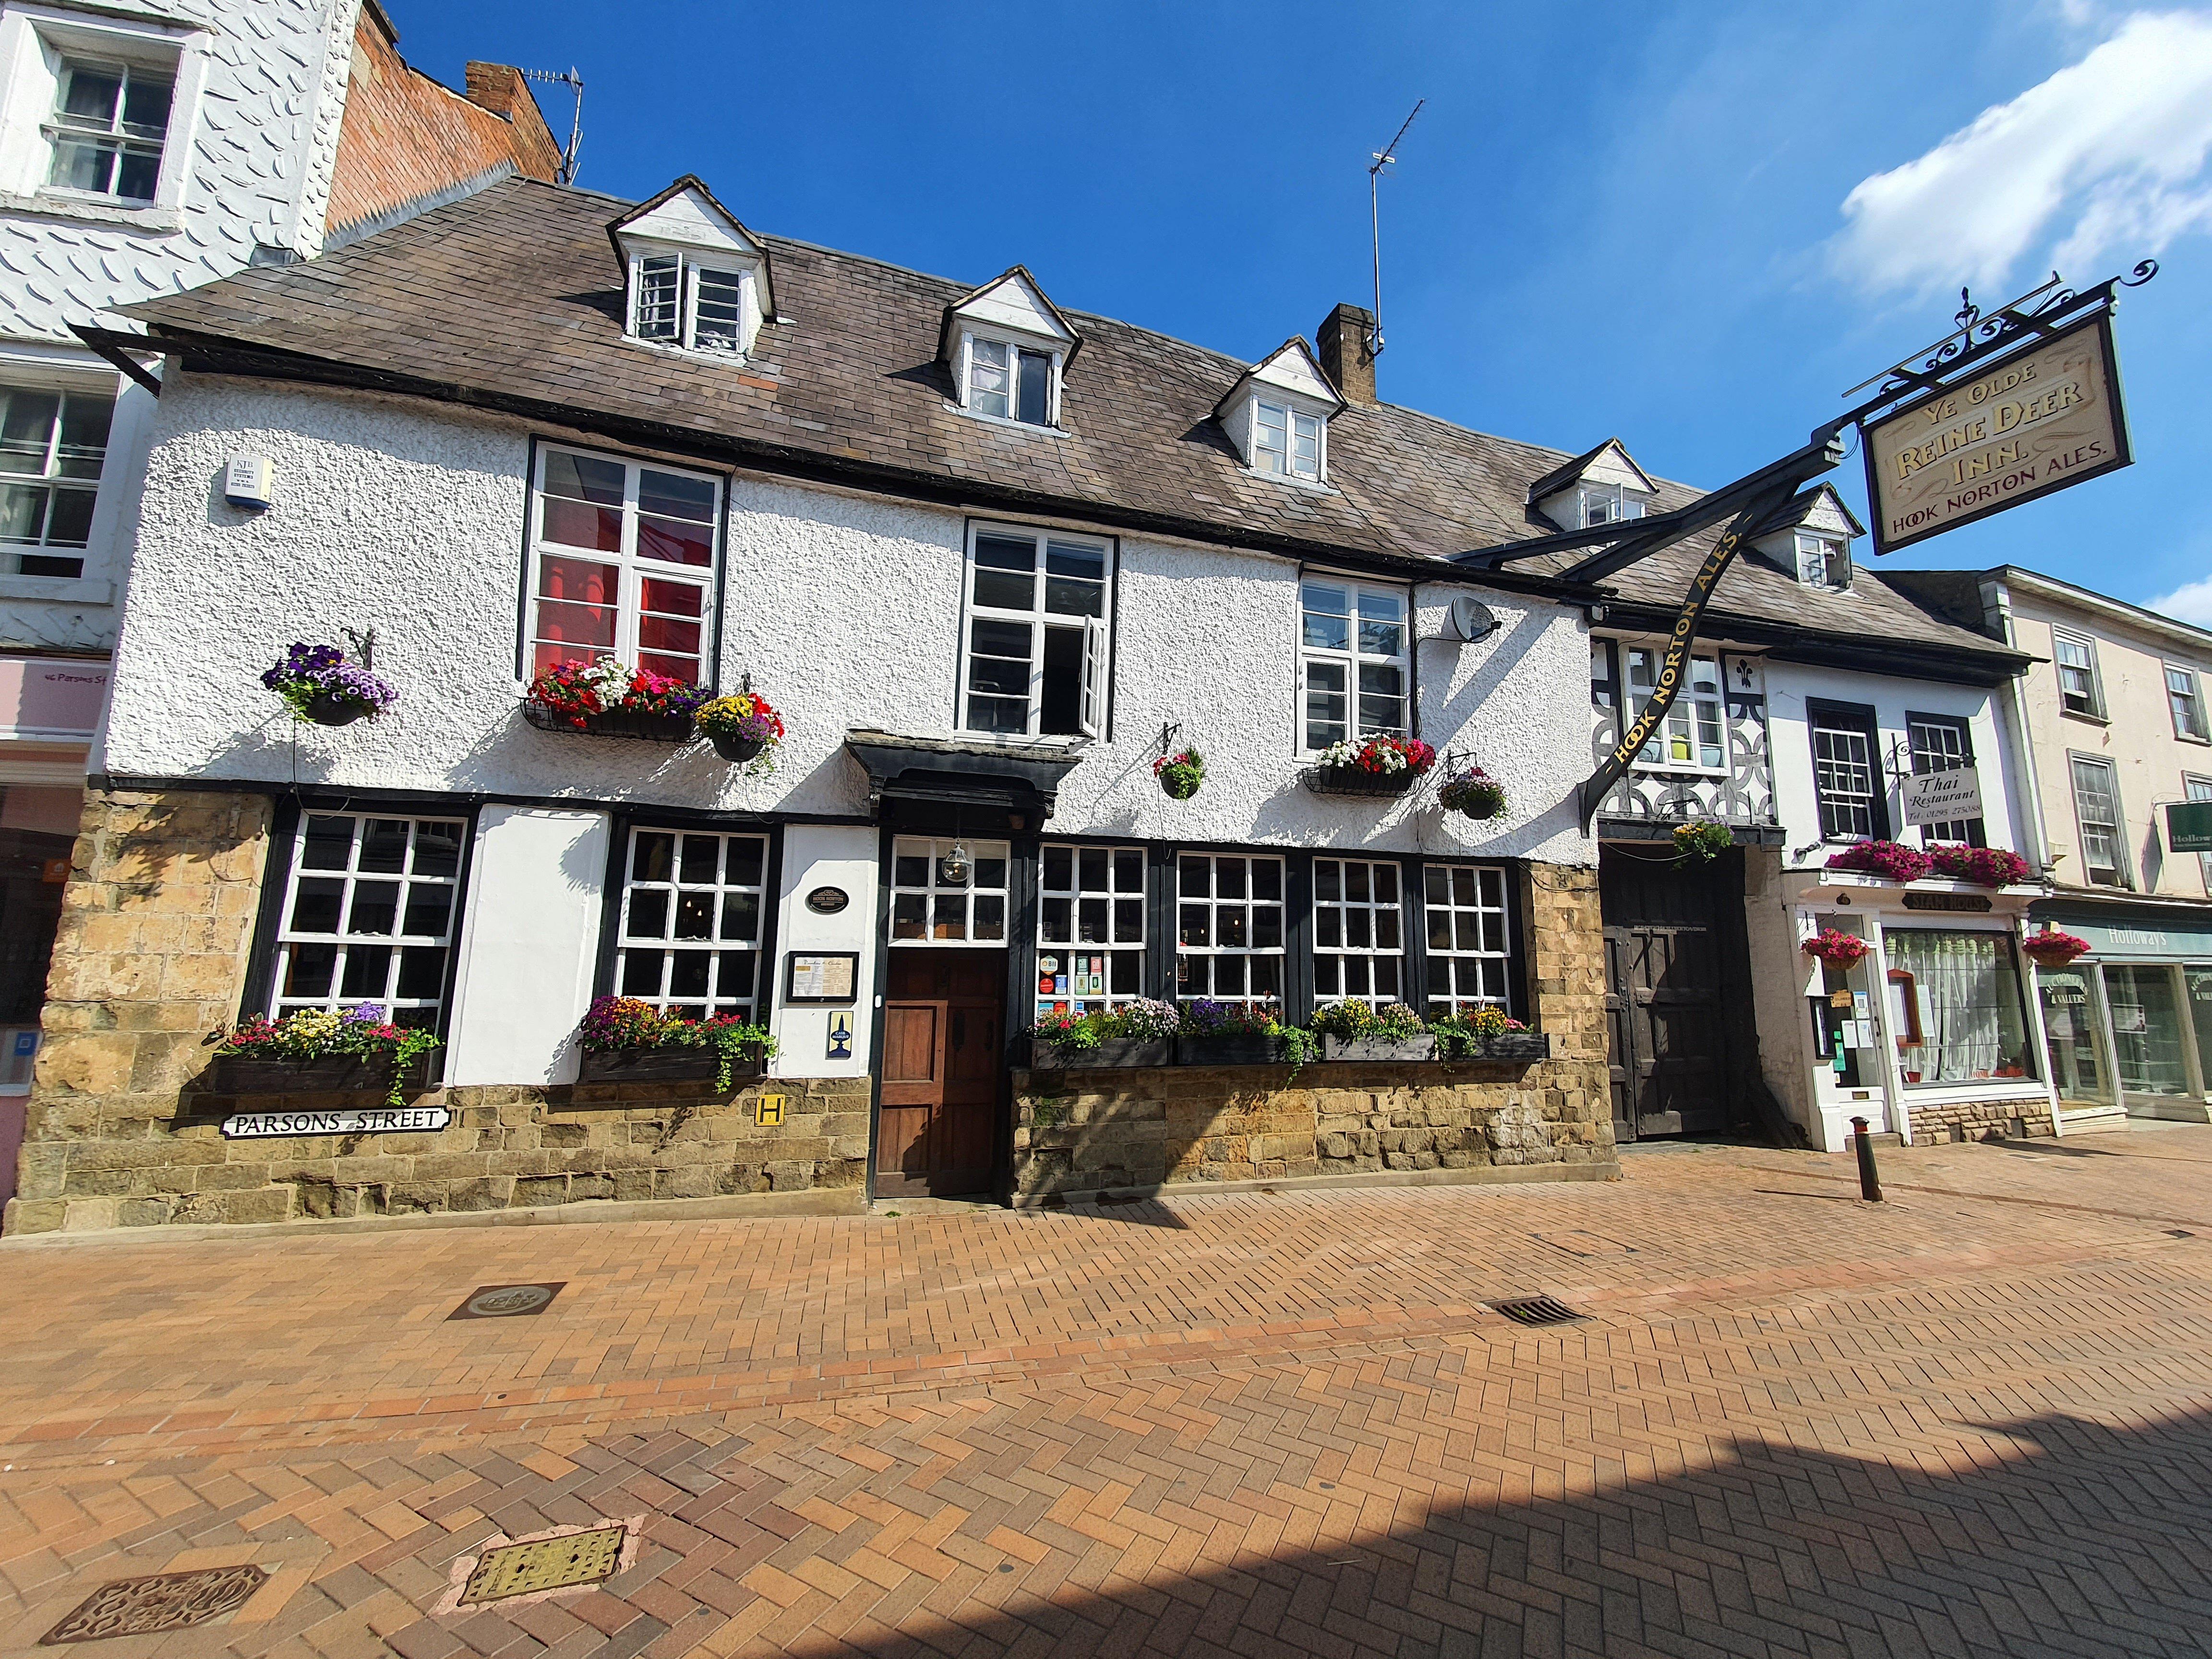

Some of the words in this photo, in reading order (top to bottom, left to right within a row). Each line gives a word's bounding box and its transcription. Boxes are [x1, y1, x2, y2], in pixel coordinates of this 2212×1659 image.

[1895, 417, 1987, 480] REINE
[1993, 382, 2084, 436] DEER
[237, 460, 253, 469] KJB
[1893, 505, 1939, 534] HOOK
[1947, 467, 2036, 513] NORTON
[2046, 441, 2107, 476] ALES.
[95, 676, 107, 685] St
[1613, 711, 1657, 764] HOOK
[1653, 601, 1698, 705] NORTON
[1919, 774, 1959, 793] Thai
[1910, 790, 1974, 808] Restaurant
[236, 1113, 340, 1133] PARSONS
[356, 1110, 440, 1128] STREET
[759, 1098, 781, 1122] H
